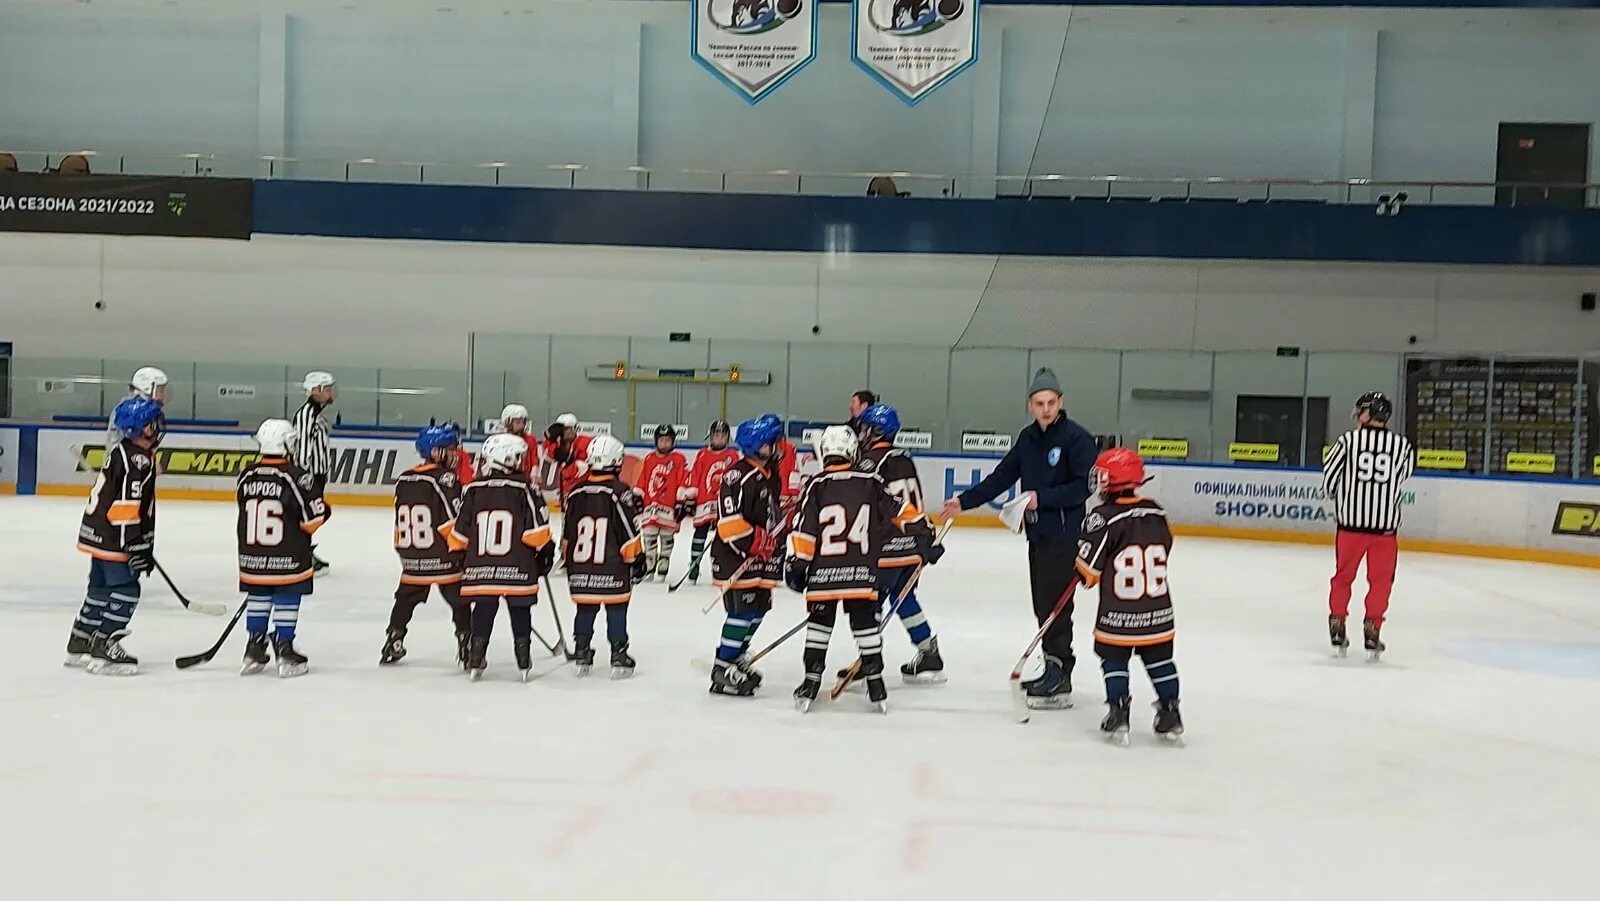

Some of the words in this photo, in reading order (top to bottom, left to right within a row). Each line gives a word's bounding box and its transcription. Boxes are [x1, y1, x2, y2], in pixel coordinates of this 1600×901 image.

[18, 197, 76, 212] СЕЗОНА
[79, 198, 155, 214] 2021/2022
[330, 448, 402, 484] MHL
[1357, 451, 1392, 484] 99
[309, 496, 326, 516] 16
[1194, 480, 1286, 499] ОФИЦИАЛЬНЫЙ
[1289, 485, 1327, 501] МАГАЗ
[245, 498, 284, 547] 16
[396, 504, 434, 549] 88
[818, 503, 872, 558] 24
[1215, 501, 1335, 523] SHOP.UGRA-
[476, 509, 513, 557] 10
[572, 516, 609, 565] 81
[1113, 543, 1168, 601] 86
